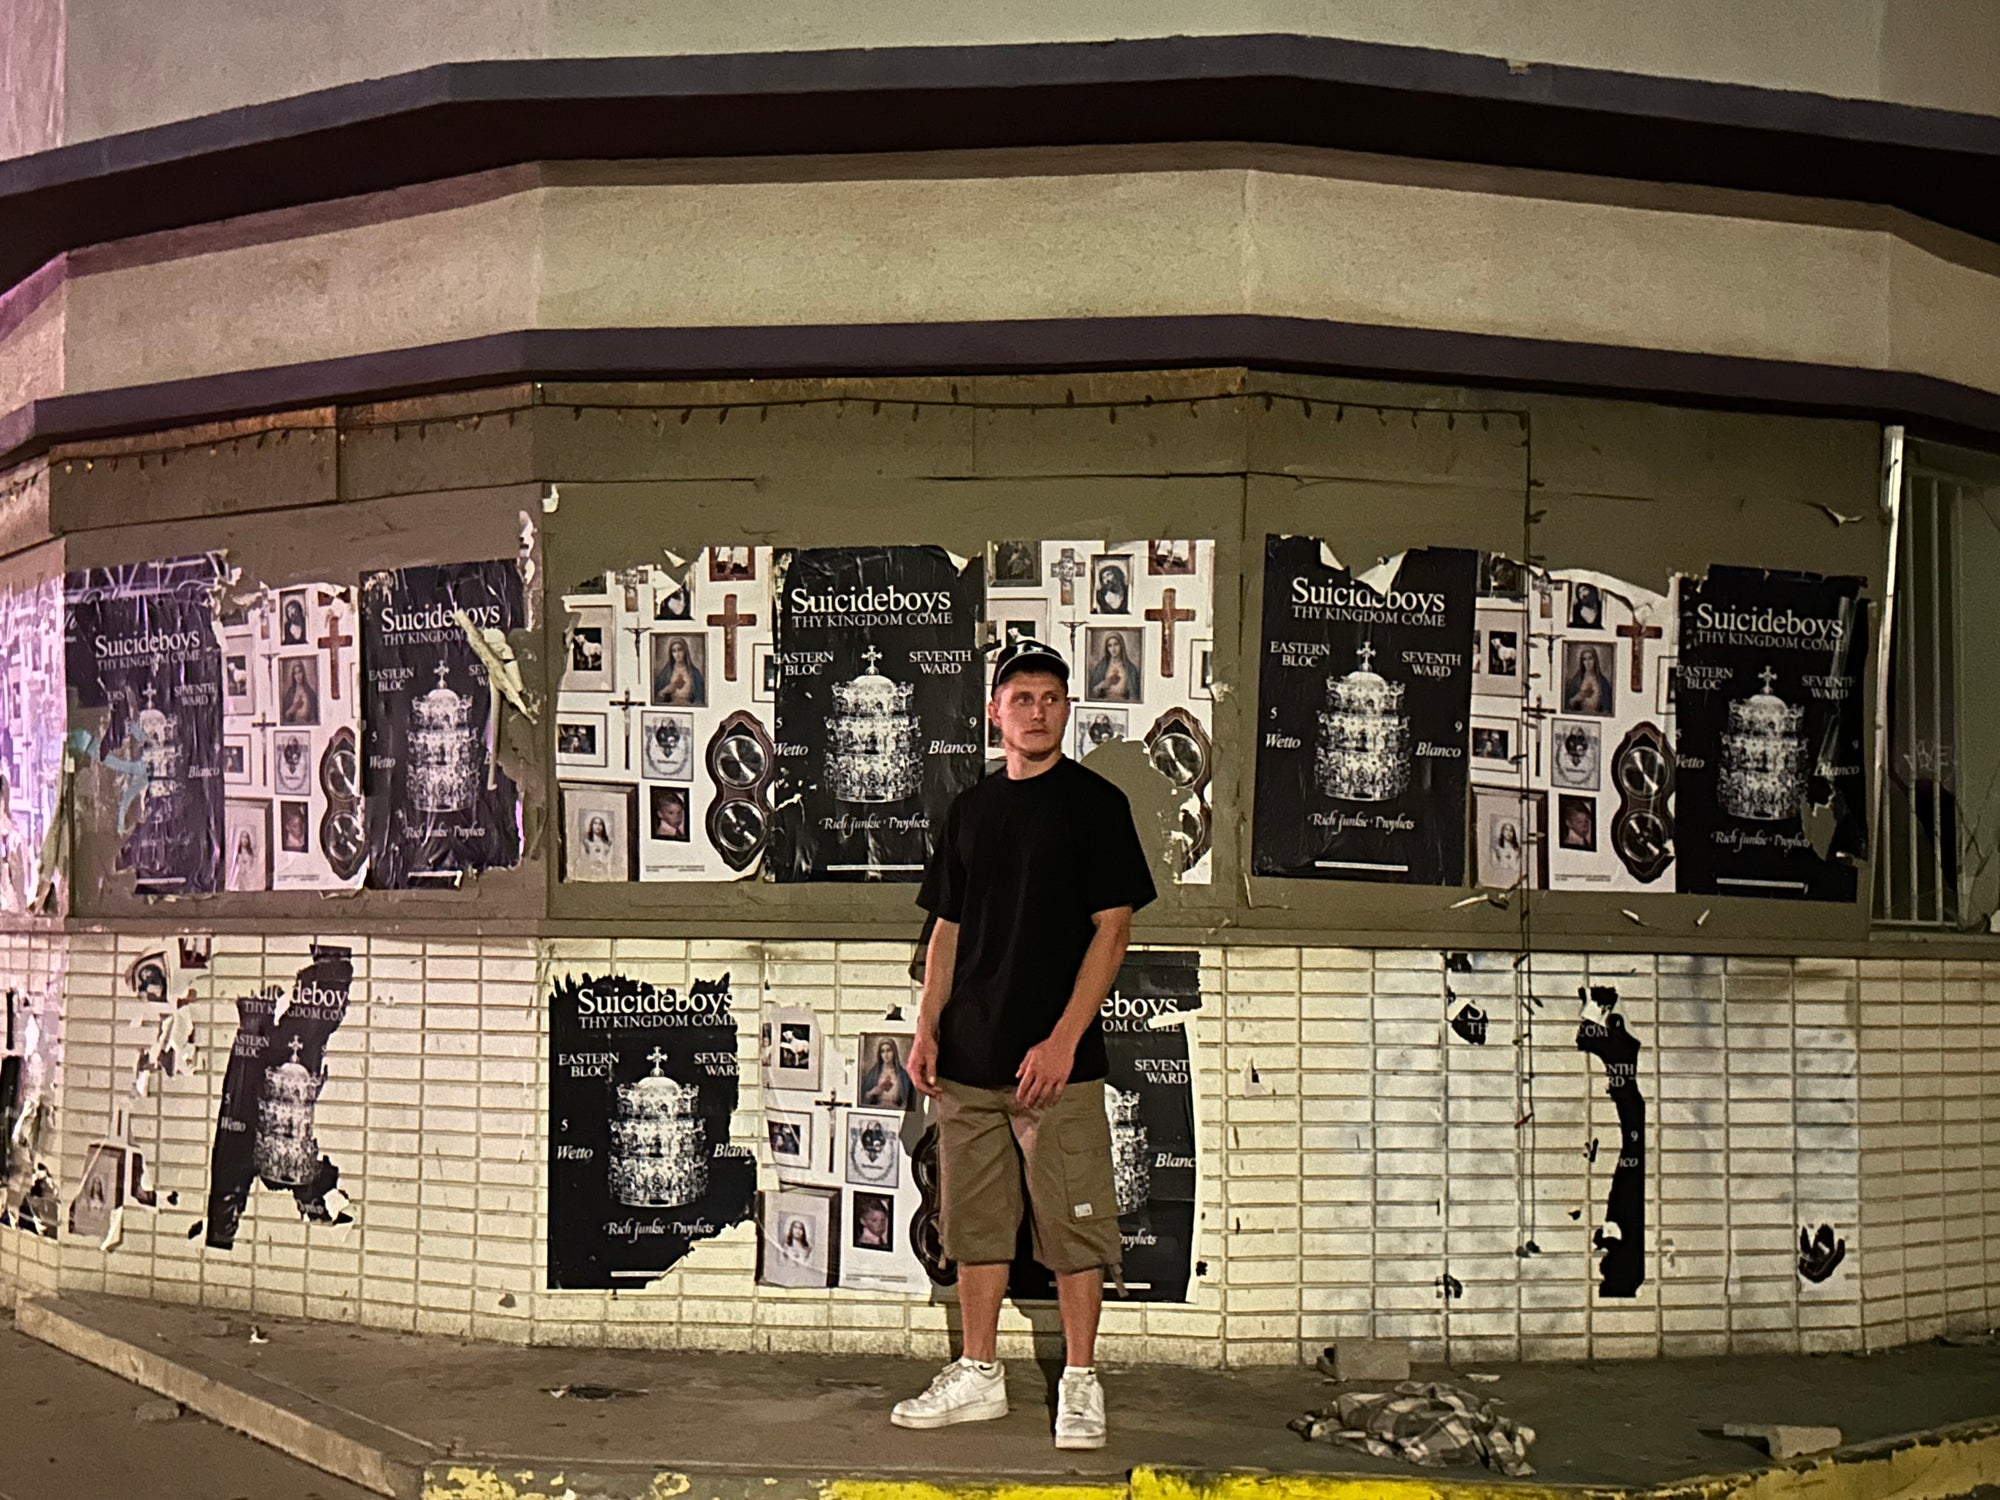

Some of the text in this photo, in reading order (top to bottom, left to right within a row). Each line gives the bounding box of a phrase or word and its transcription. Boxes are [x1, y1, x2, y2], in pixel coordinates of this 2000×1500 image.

[791, 585, 952, 617] Suicideboys
[791, 612, 953, 628] THY KINGDOM COME
[1292, 604, 1447, 628] THY KINGDOM COME
[1696, 602, 1844, 640] Suicideboys
[95, 627, 200, 660] Suicideboys
[383, 633, 407, 647] THY
[408, 629, 465, 645] KINGDOM
[1697, 630, 1844, 652] THY KINGDOM COME
[1270, 640, 1331, 656] EASTERN
[773, 651, 834, 665] EASTERN
[909, 650, 972, 663] SEVENTH
[1282, 654, 1319, 668] BLOC
[1401, 651, 1462, 666] SEVENTH
[97, 658, 119, 671] THY
[785, 663, 822, 676] BLOC
[920, 663, 962, 675] WARD
[1412, 664, 1452, 677] WARD
[368, 666, 415, 682] EASTERN
[1675, 664, 1734, 680] EASTERN
[377, 680, 406, 693] BLOC
[1687, 676, 1722, 691] BLOC
[1811, 687, 1849, 700] WARD
[1270, 706, 1278, 719] 5
[776, 717, 783, 729] 5
[969, 717, 977, 728] 9
[1454, 720, 1463, 733] 9
[371, 731, 378, 743] 5
[1265, 733, 1302, 749] Wetto
[772, 742, 809, 757] Wetto
[928, 740, 977, 755] Blanco
[1415, 741, 1462, 758] Blanco
[369, 755, 396, 769] Wetto
[1813, 761, 1860, 777] Blanco
[244, 1001, 265, 1014] THY
[578, 1016, 612, 1029] THY
[613, 1014, 689, 1028] KINGDOM
[235, 1033, 270, 1048] ASTERN
[234, 1045, 260, 1058] BLOC
[693, 1052, 738, 1065] SEVEN
[558, 1052, 620, 1066] EASTERN
[1134, 1059, 1189, 1072] SEVENT
[571, 1065, 607, 1078] BLOC
[1145, 1072, 1188, 1085] WARD
[560, 1118, 569, 1131] 5
[1630, 1130, 1639, 1142] 9
[557, 1144, 594, 1160] Wetto
[713, 1143, 752, 1158] Blanc
[1155, 1152, 1196, 1168] Blanc
